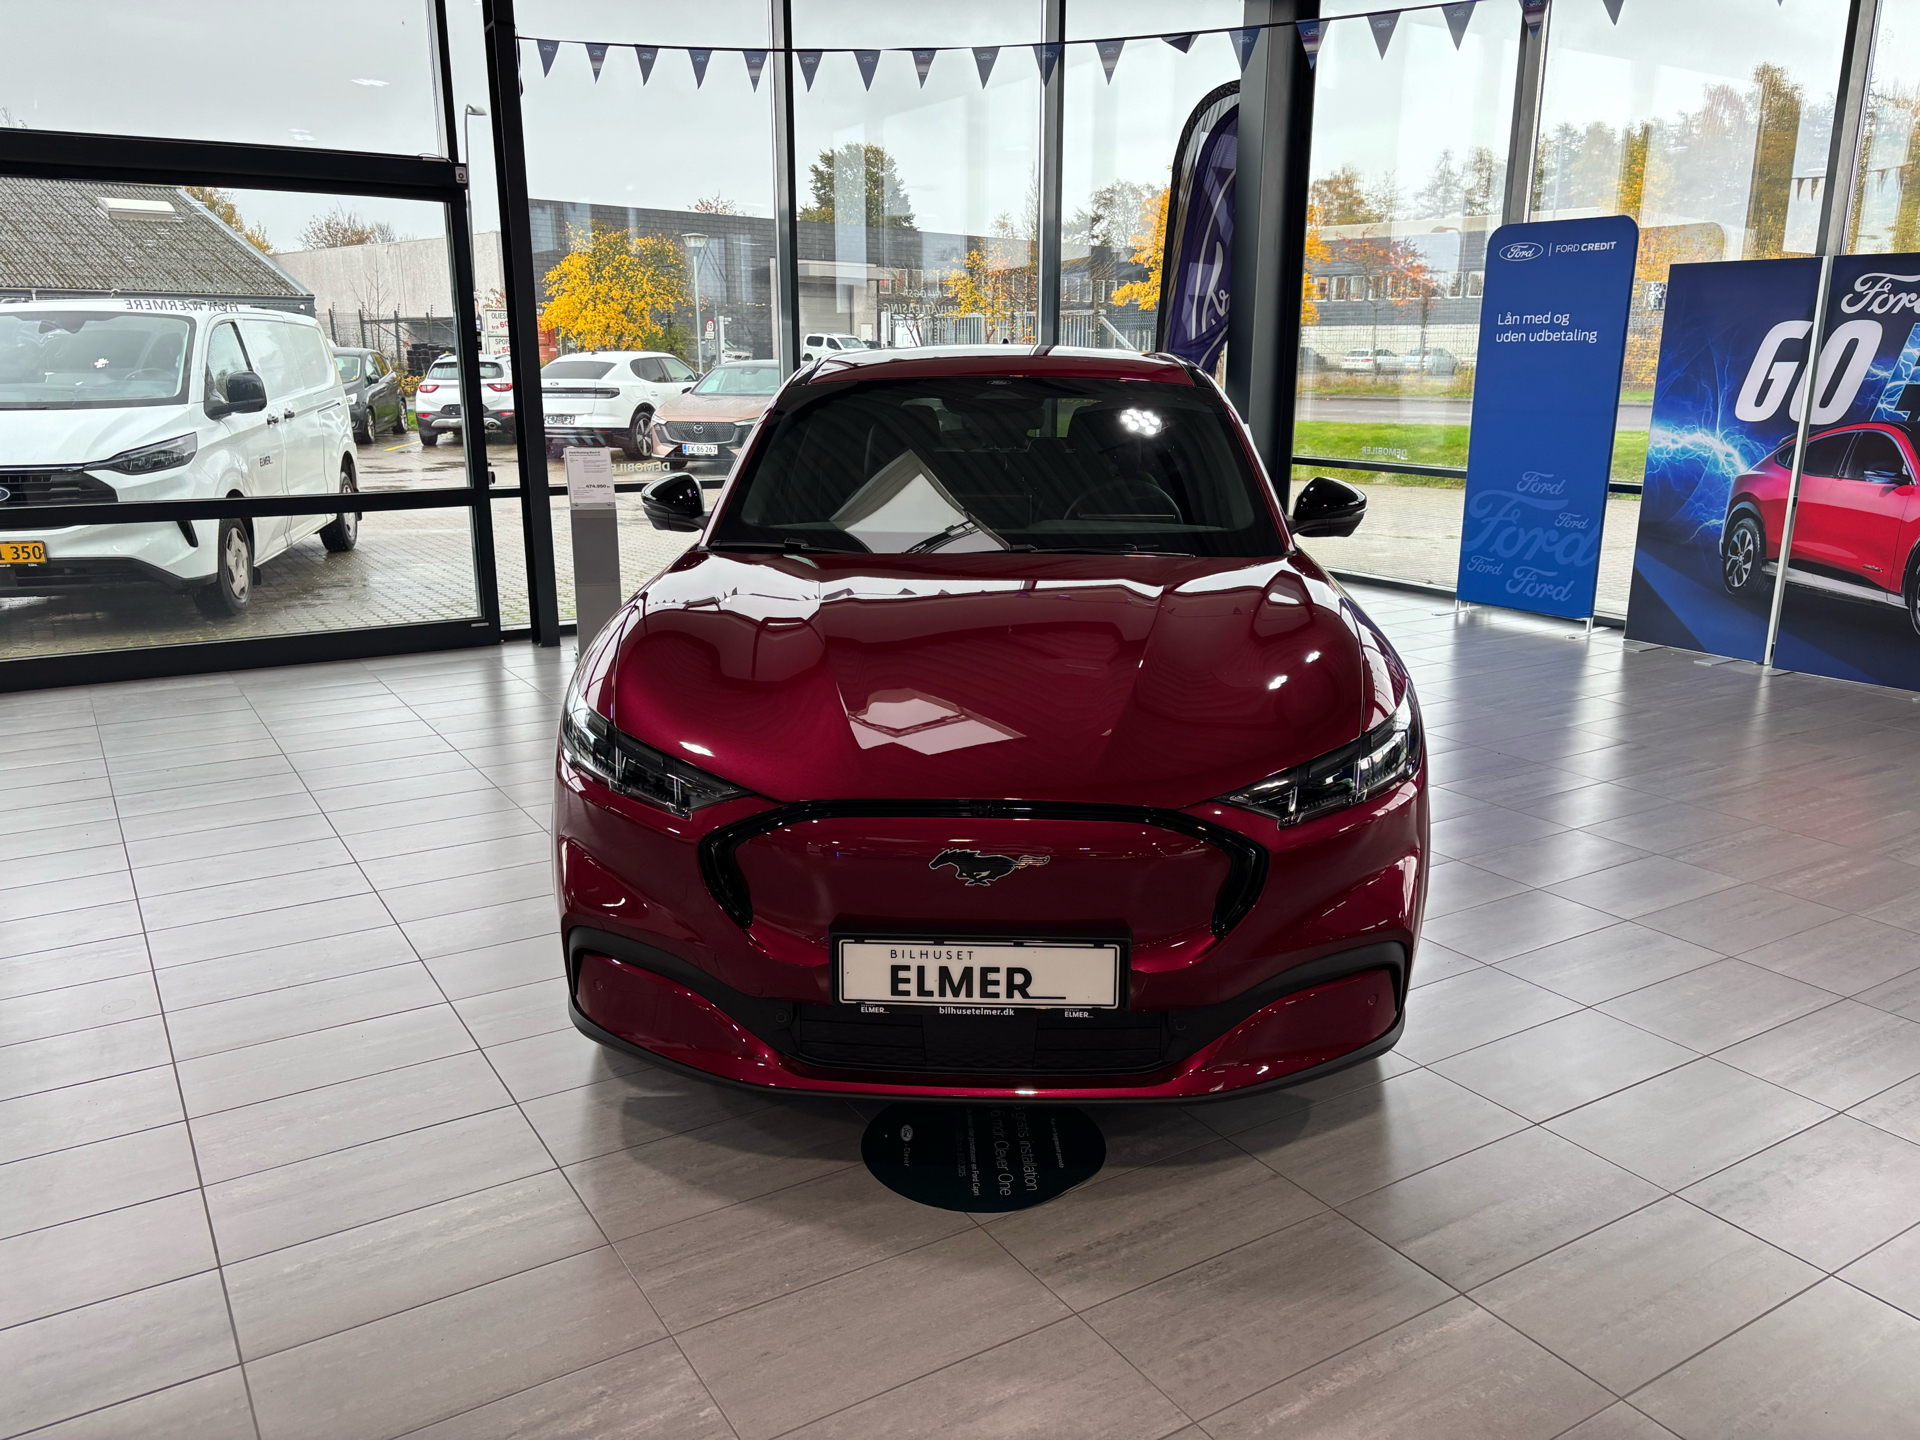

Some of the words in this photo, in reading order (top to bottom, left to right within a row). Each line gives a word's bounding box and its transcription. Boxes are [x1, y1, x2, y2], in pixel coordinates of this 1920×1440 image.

[1507, 245, 1536, 258] Ford
[1556, 244, 1580, 253] FORD
[1581, 241, 1617, 252] CREDIT
[1497, 312, 1520, 326] Lån
[1522, 312, 1551, 325] med
[1553, 313, 1570, 326] og
[1495, 330, 1526, 343] uden
[1529, 329, 1598, 344] udbetaling
[1735, 319, 1883, 425] GO
[1516, 470, 1566, 496] Ford
[1462, 489, 1601, 568] Ford
[1554, 512, 1589, 530] Ford
[9, 545, 42, 560] 350
[1466, 554, 1504, 576] Ford
[1505, 565, 1575, 602] Ford
[890, 949, 974, 960] BILHUSET
[890, 964, 1035, 1000] ELMER
[939, 1006, 1015, 1016] bilhusetelmer.dk
[1064, 1011, 1089, 1019] ELMER
[1012, 1112, 1032, 1138] gratis
[903, 1147, 911, 1167] Clever
[994, 1140, 1011, 1170] Clever
[1019, 1140, 1040, 1191] installation
[997, 1173, 1014, 1196] One
